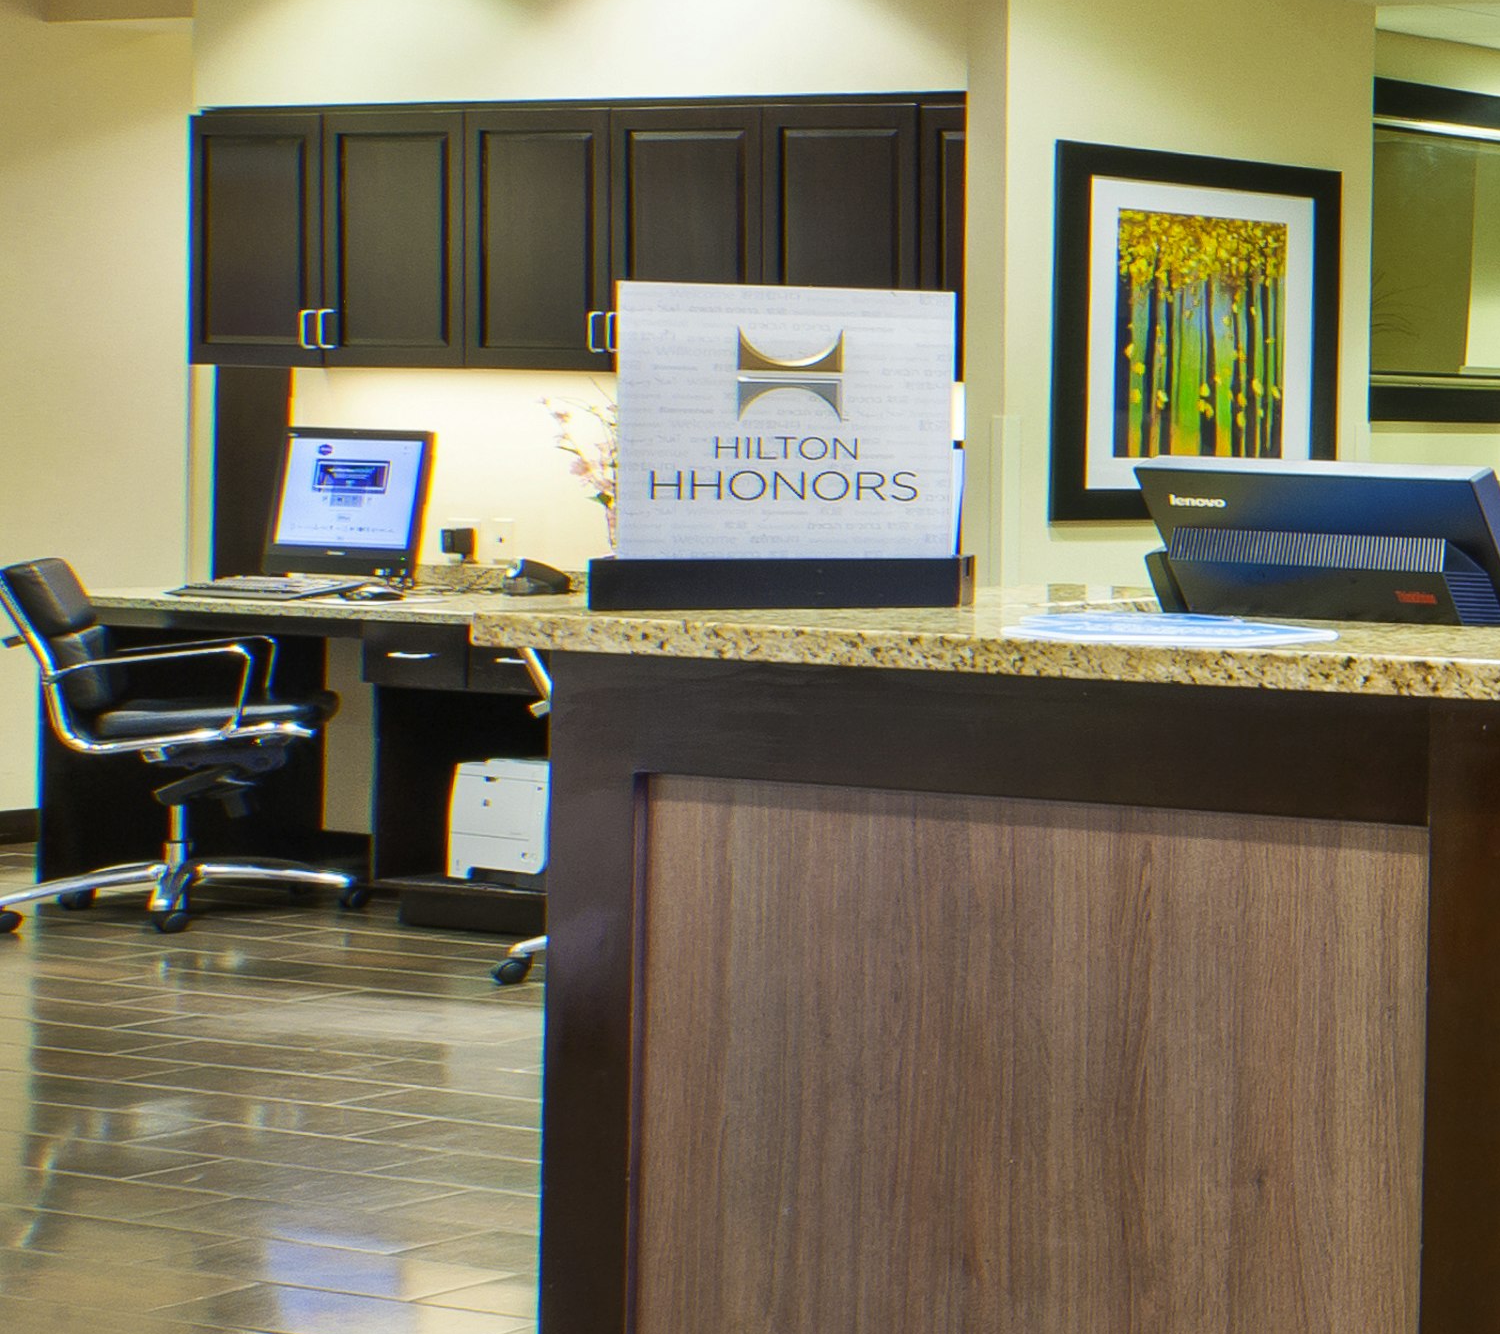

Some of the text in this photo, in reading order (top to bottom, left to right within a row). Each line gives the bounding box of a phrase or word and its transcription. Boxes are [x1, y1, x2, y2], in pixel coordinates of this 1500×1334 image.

[714, 435, 859, 461] HILTON
[650, 469, 920, 502] HHONORS
[1169, 493, 1227, 509] lenovo
